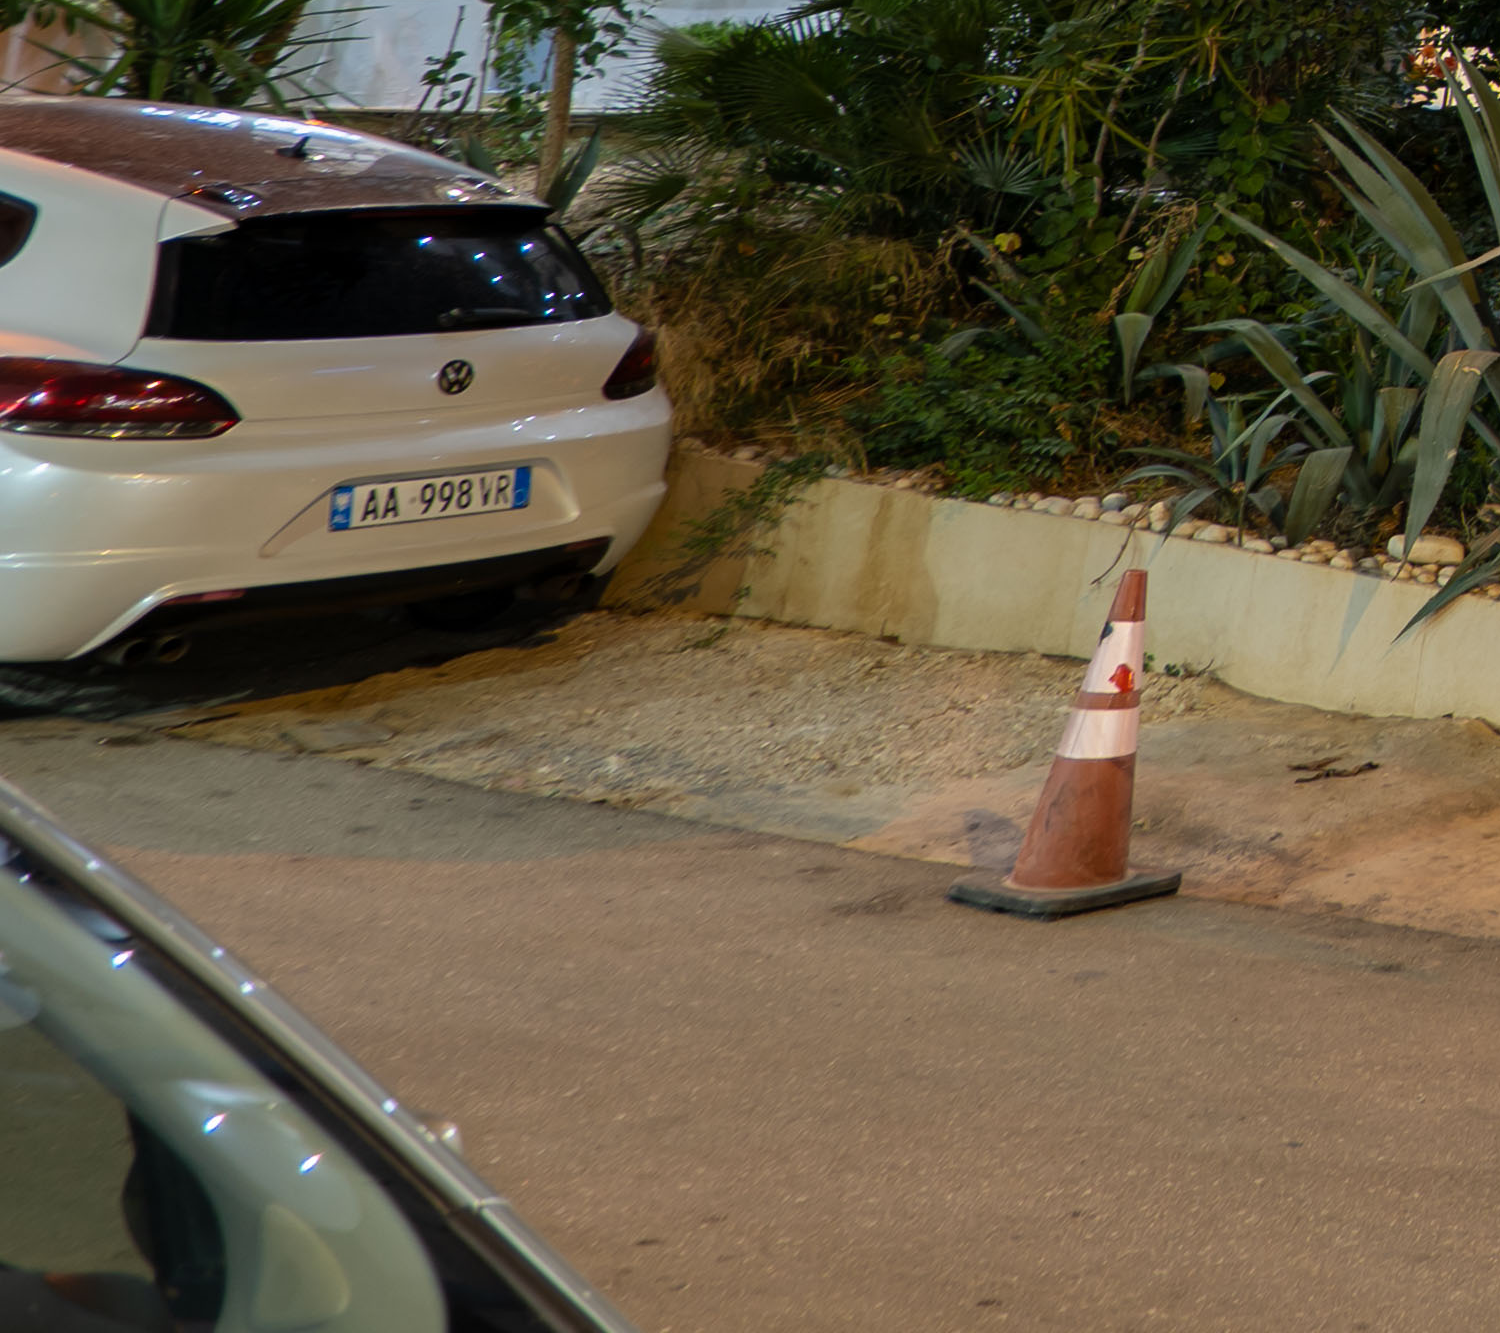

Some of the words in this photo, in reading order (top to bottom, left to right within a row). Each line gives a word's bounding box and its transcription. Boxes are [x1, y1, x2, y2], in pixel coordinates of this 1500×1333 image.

[360, 486, 400, 522] AA
[420, 479, 473, 515] 998
[480, 474, 511, 507] VR
